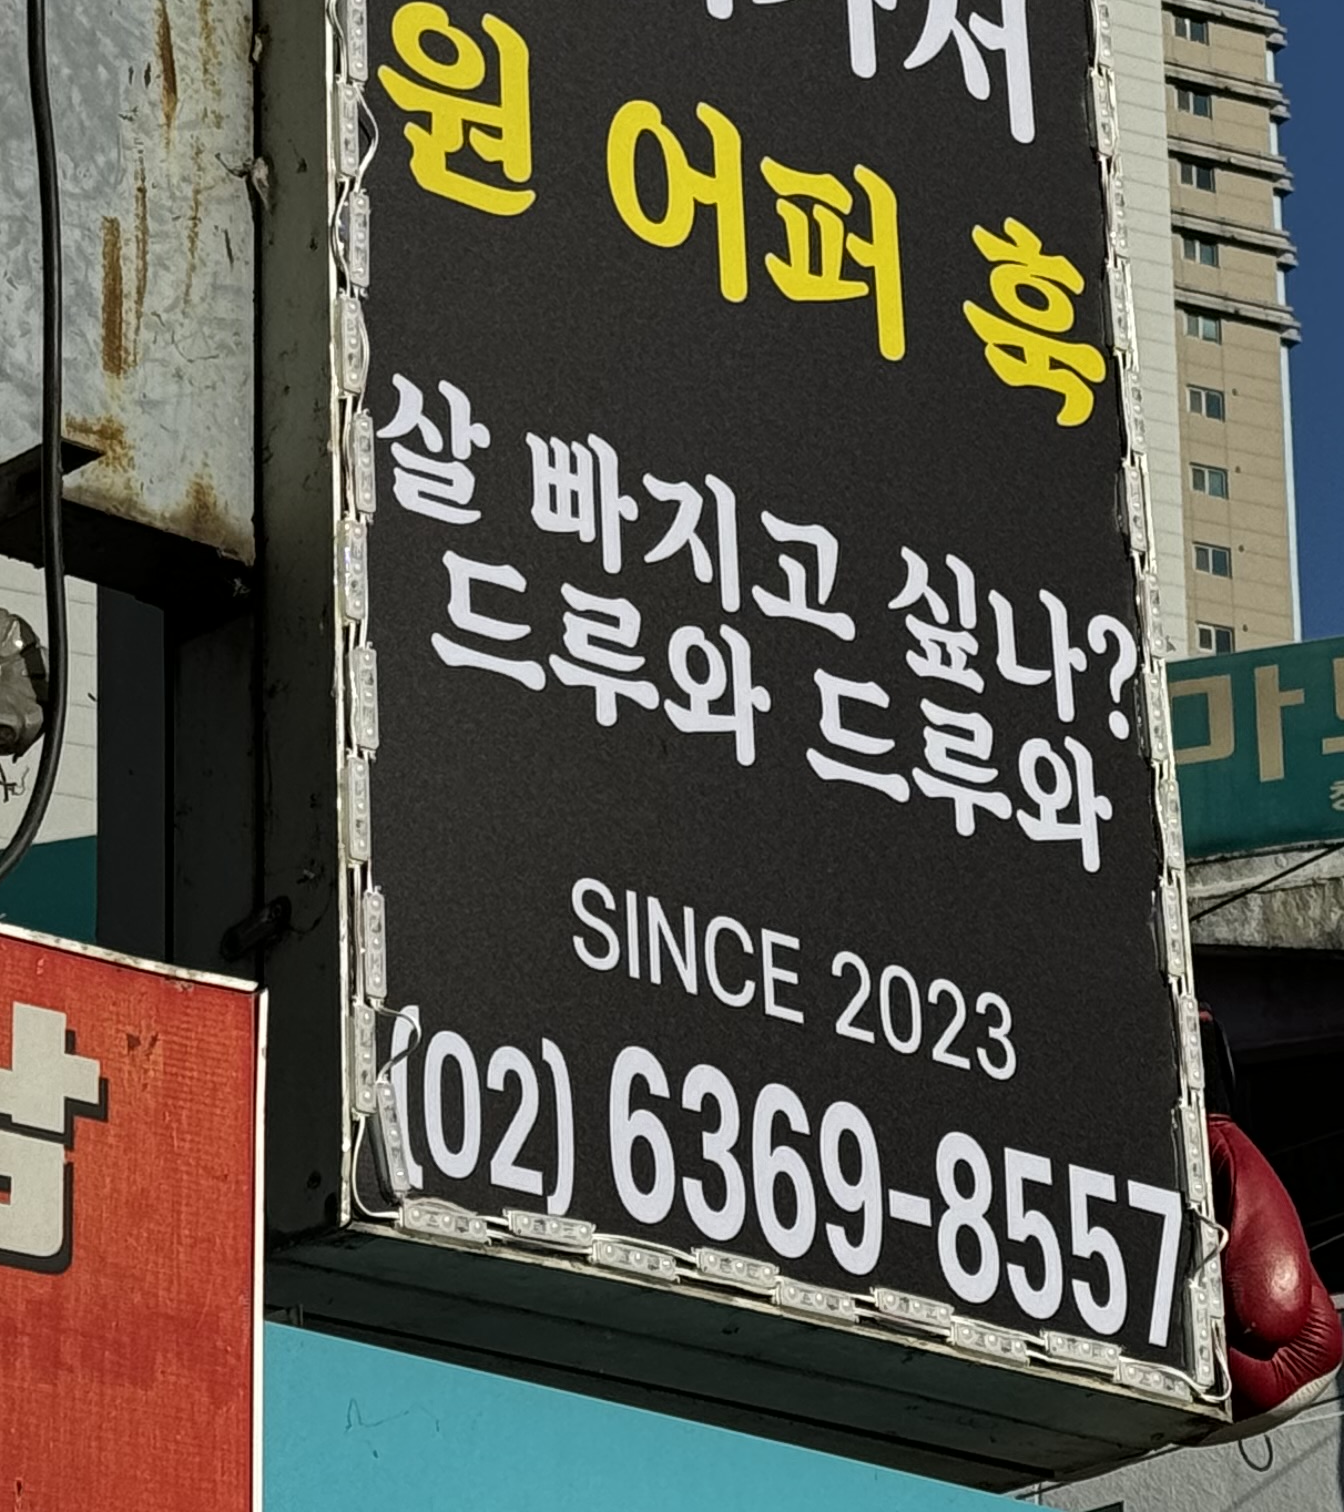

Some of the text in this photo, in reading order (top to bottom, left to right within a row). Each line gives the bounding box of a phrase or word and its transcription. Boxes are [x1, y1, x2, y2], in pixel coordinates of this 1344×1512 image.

[378, 1, 1106, 426] 원 어퍼 훅
[378, 373, 1137, 740] 살 빠지고 싶나?
[431, 550, 1113, 872] 드루와 드루와
[571, 878, 1017, 1082] SINCE 2023
[391, 1005, 1184, 1347] (02) 6369-8557
